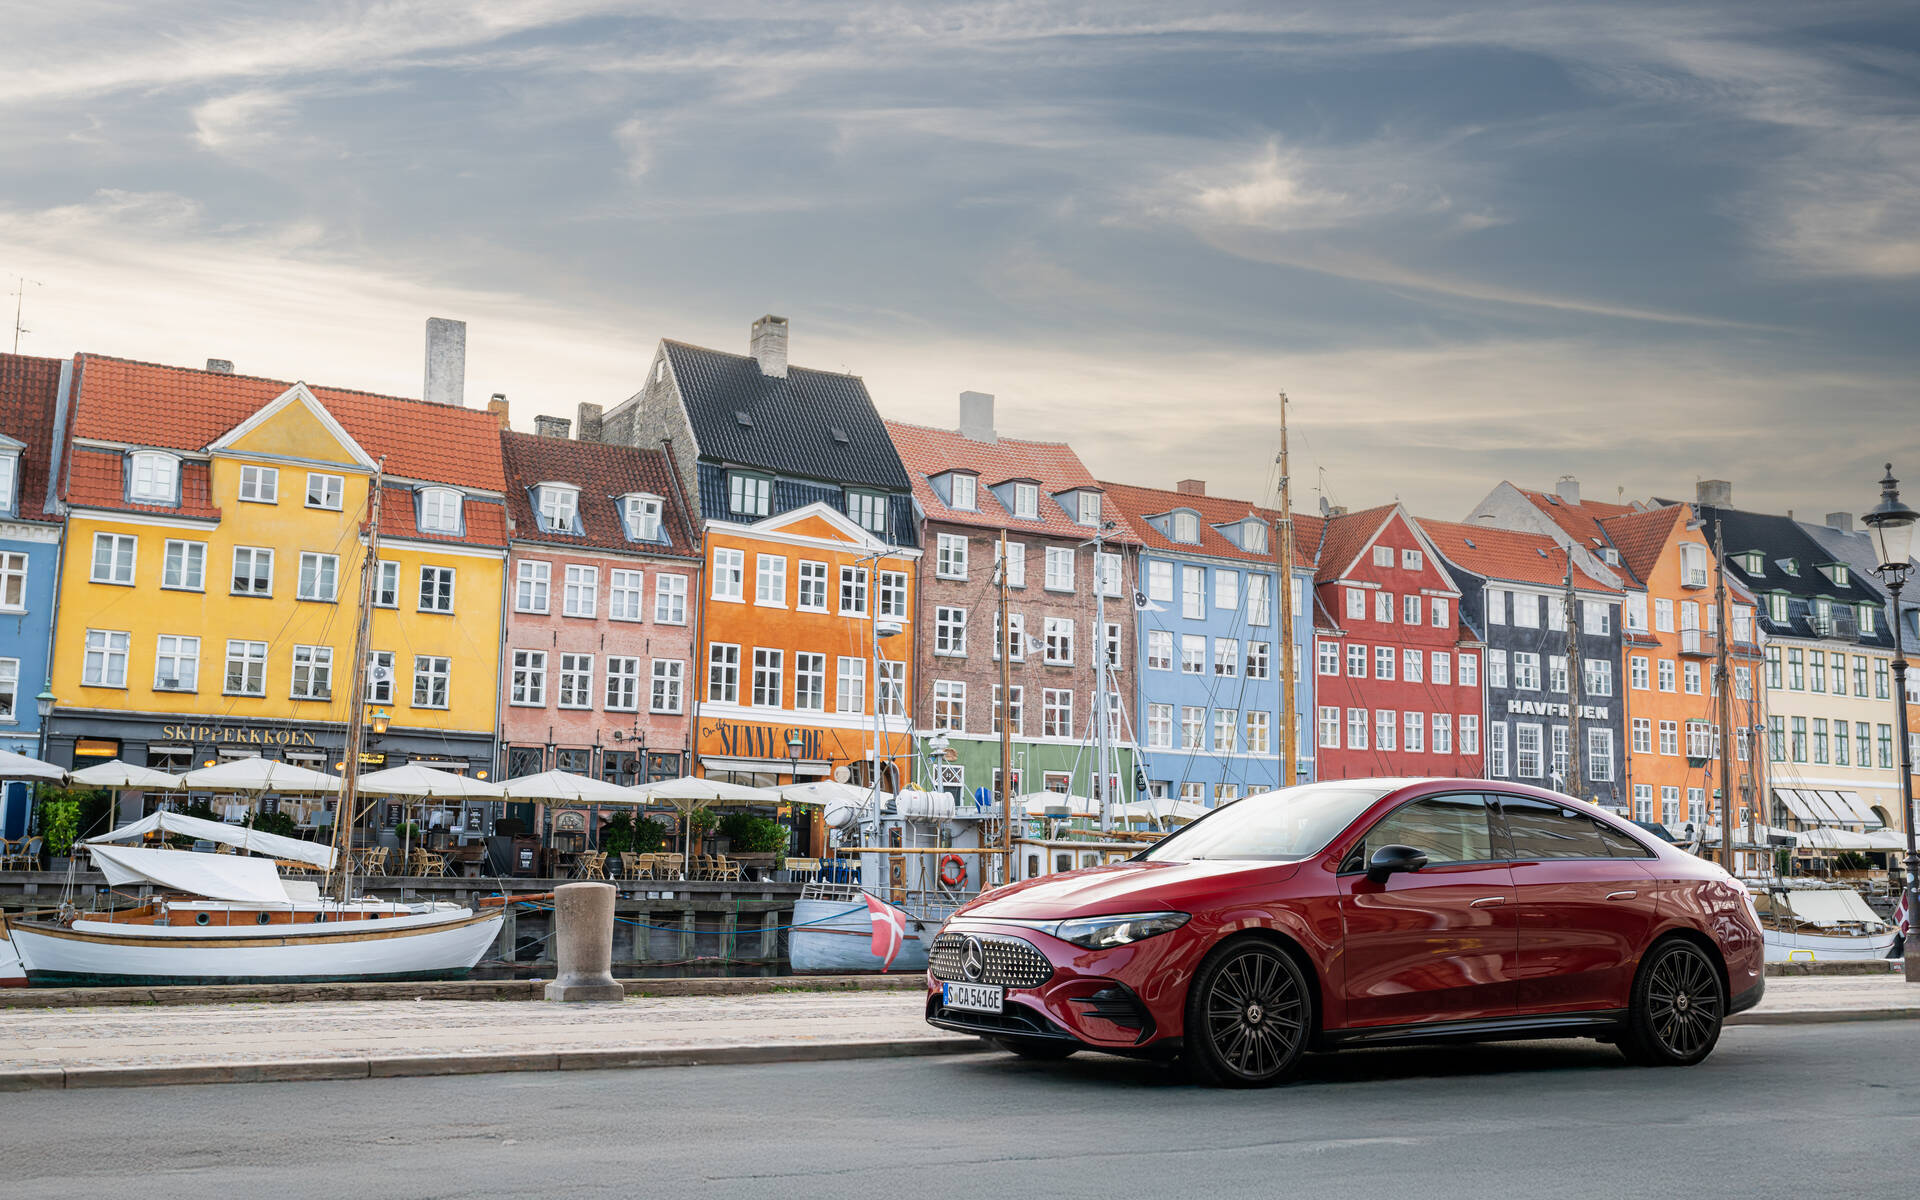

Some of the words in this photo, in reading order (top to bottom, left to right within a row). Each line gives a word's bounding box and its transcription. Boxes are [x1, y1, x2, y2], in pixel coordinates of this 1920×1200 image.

[720, 724, 779, 759] SUNNY
[783, 727, 824, 761] SDE
[948, 986, 954, 1004] S
[958, 987, 969, 1006] CA
[970, 988, 1001, 1009] 5416E
